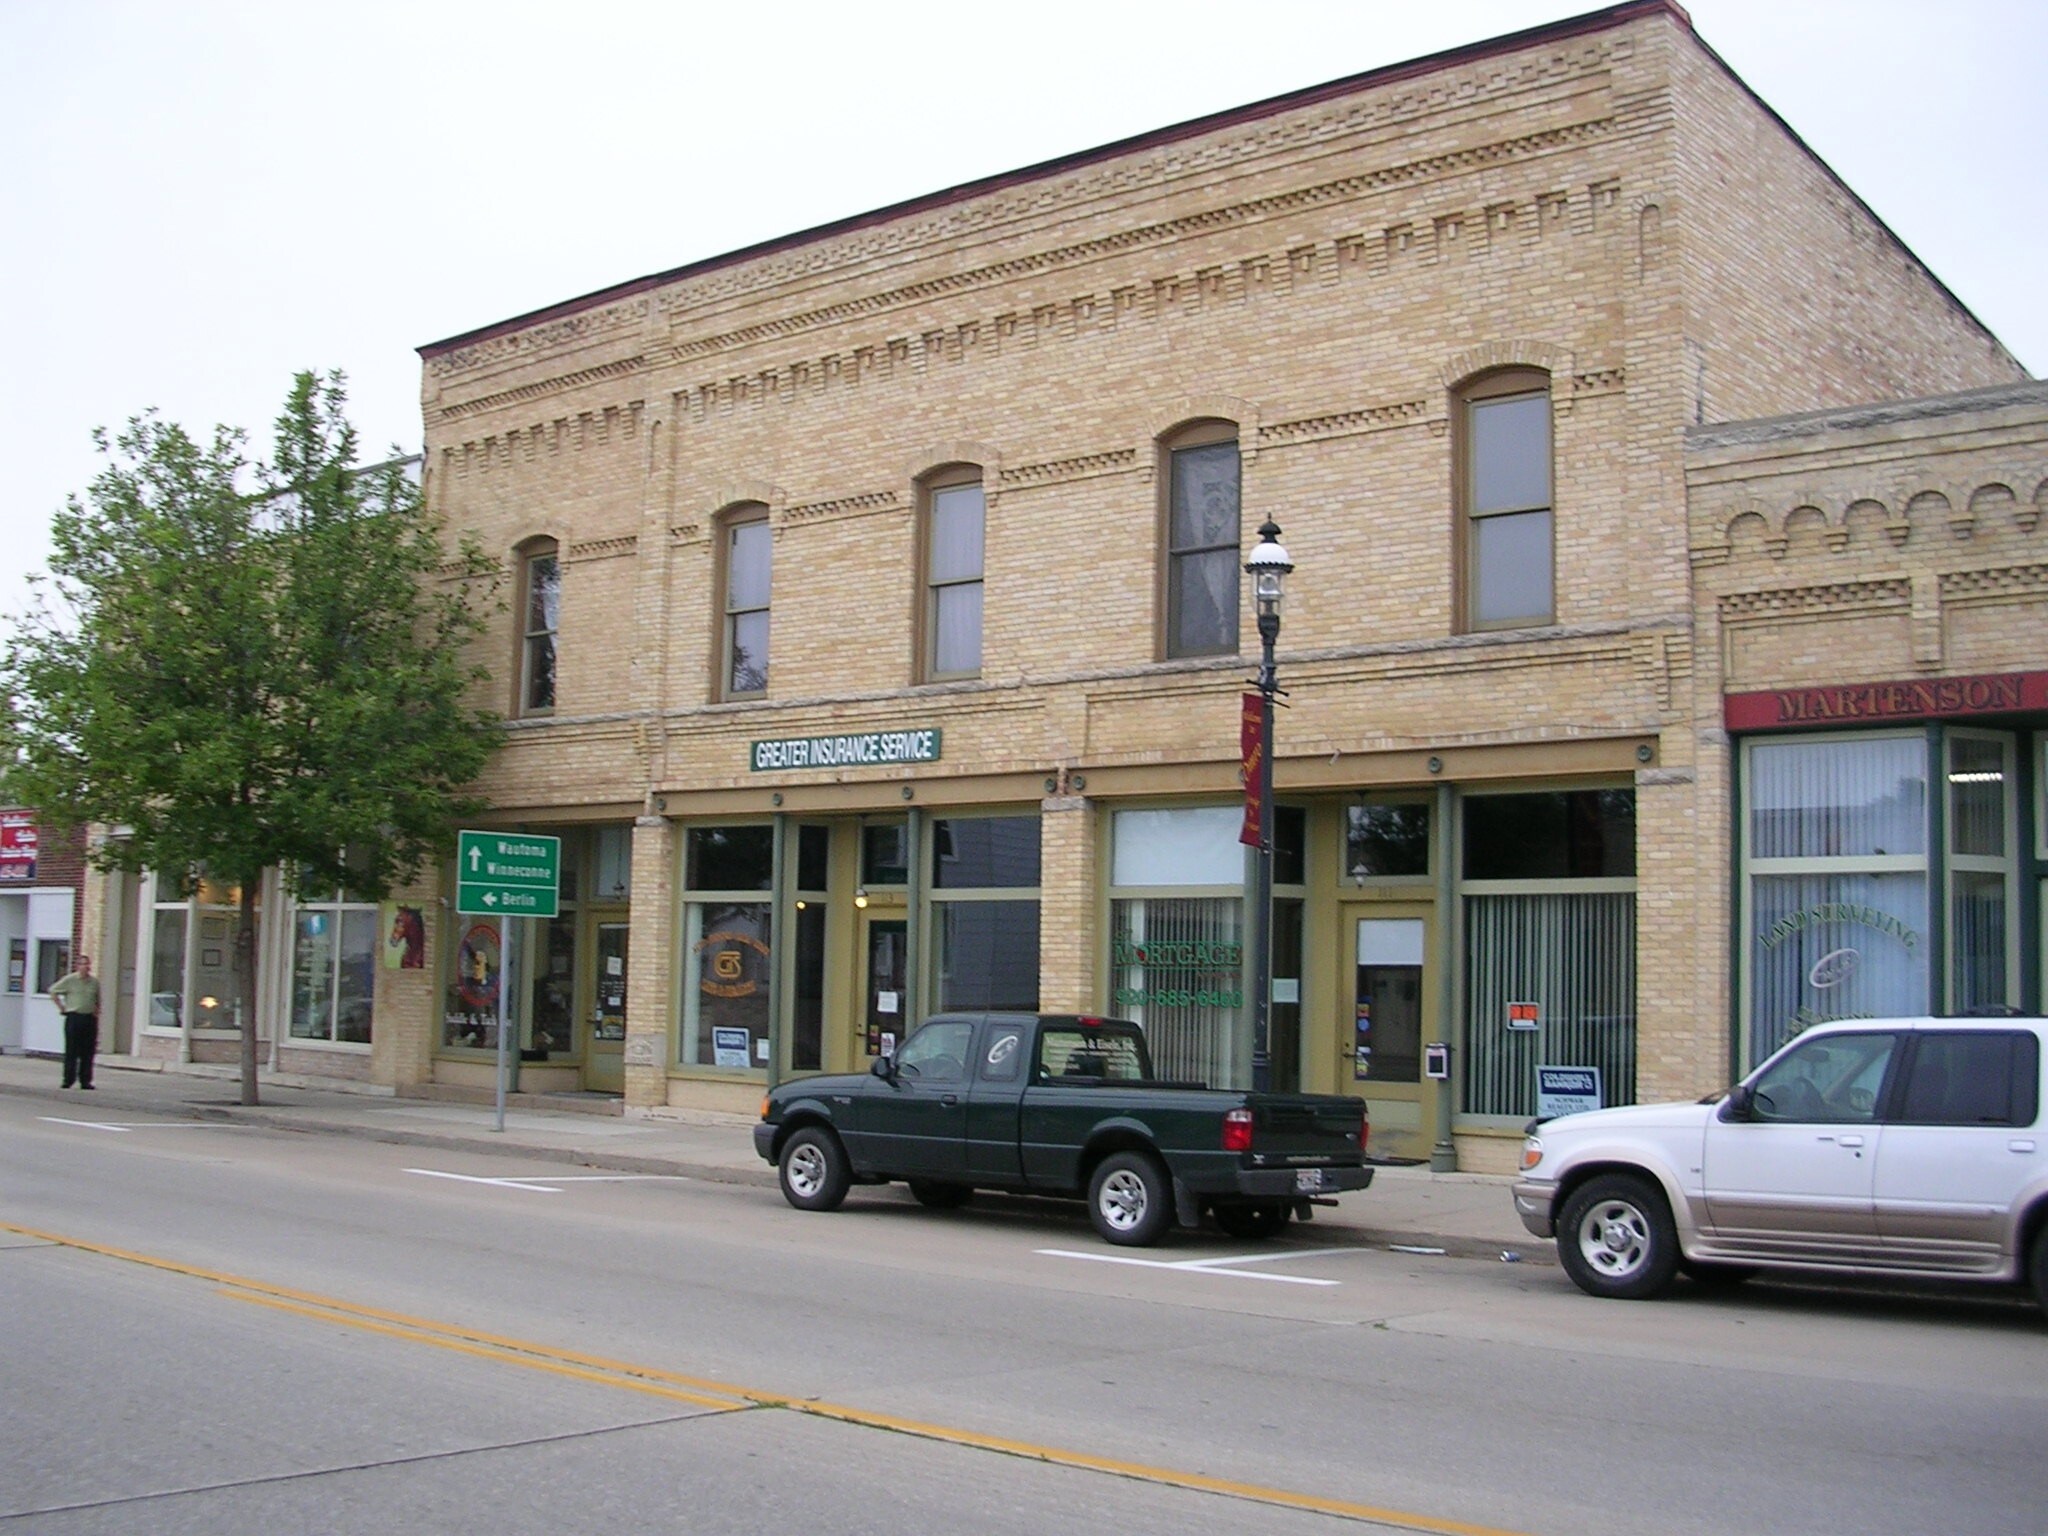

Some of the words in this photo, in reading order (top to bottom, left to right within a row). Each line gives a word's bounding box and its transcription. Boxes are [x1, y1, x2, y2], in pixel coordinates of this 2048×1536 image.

[1778, 677, 2024, 721] MARTENSON
[756, 740, 809, 768] GREATER
[810, 735, 879, 765] INSURANCE
[880, 731, 933, 761] SERVICE
[497, 841, 547, 858] Wautoma
[487, 862, 551, 879] Winneconne
[502, 892, 536, 906] Berlin
[1758, 910, 1808, 948] LAND
[1811, 903, 1919, 949] SURVEYING
[1113, 942, 1242, 966] MORTGAGE
